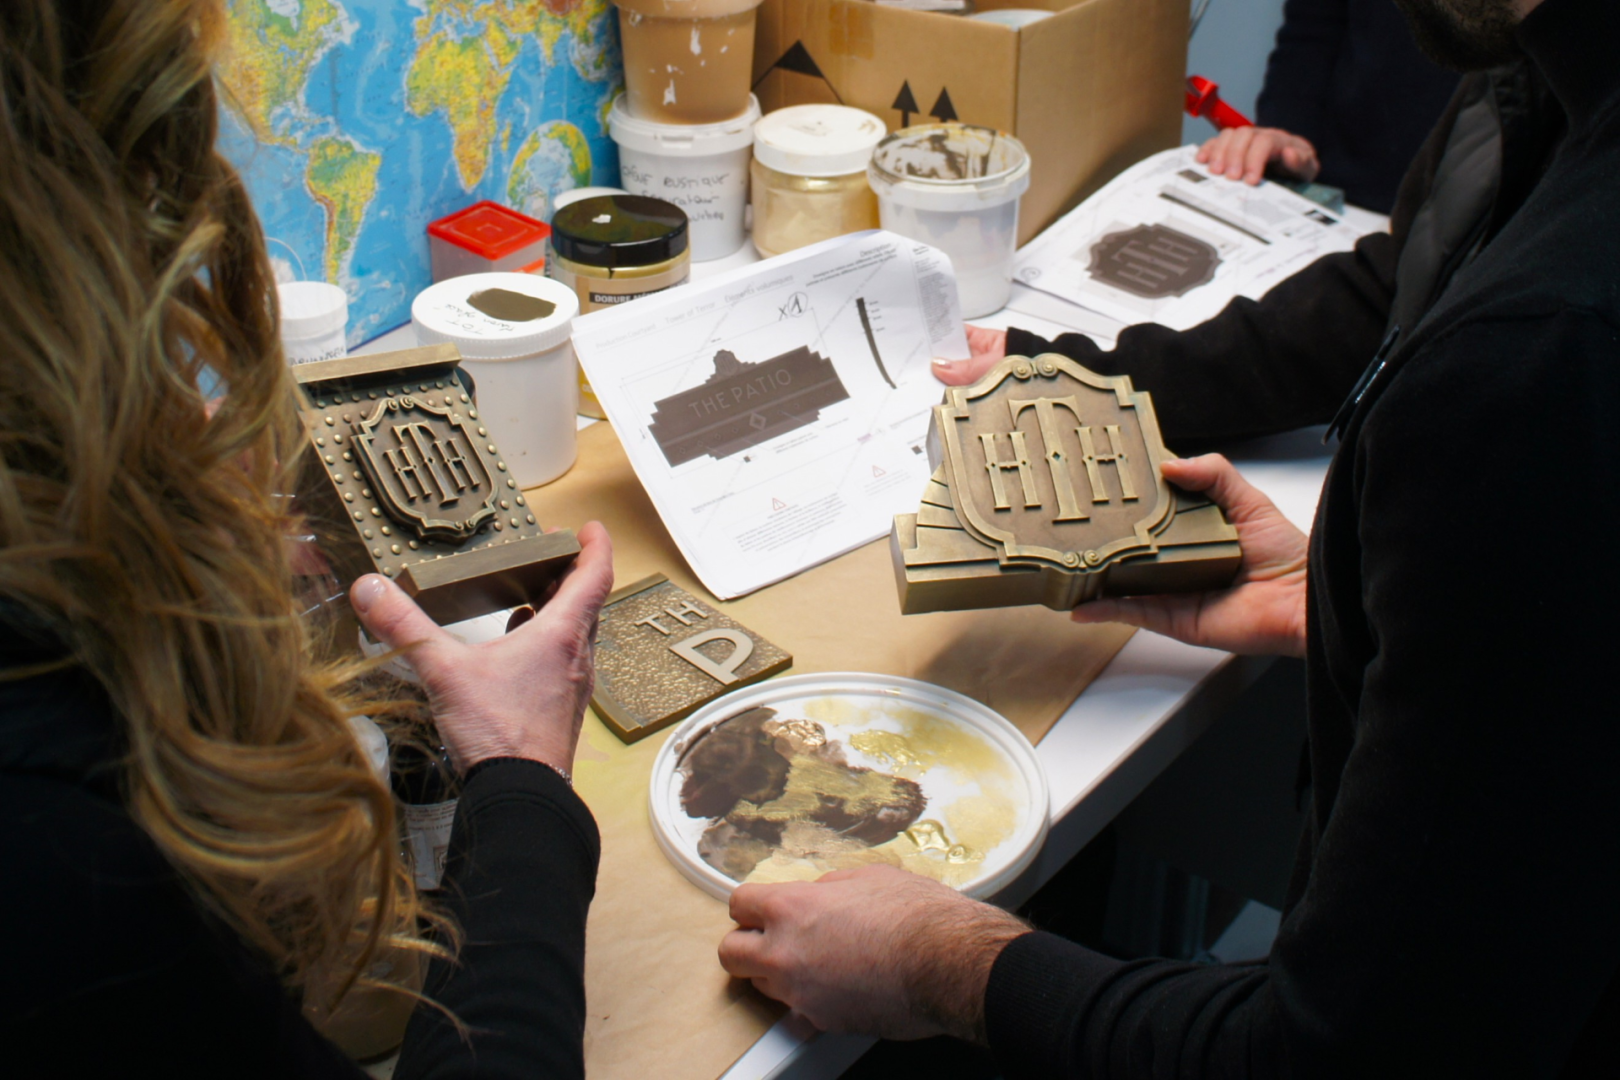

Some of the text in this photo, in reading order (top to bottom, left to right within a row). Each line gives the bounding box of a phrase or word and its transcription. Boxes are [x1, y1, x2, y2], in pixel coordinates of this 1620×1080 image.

[594, 294, 631, 303] DORURE
[665, 302, 716, 324] Tower of Terror
[688, 369, 791, 418] THE PATIO
